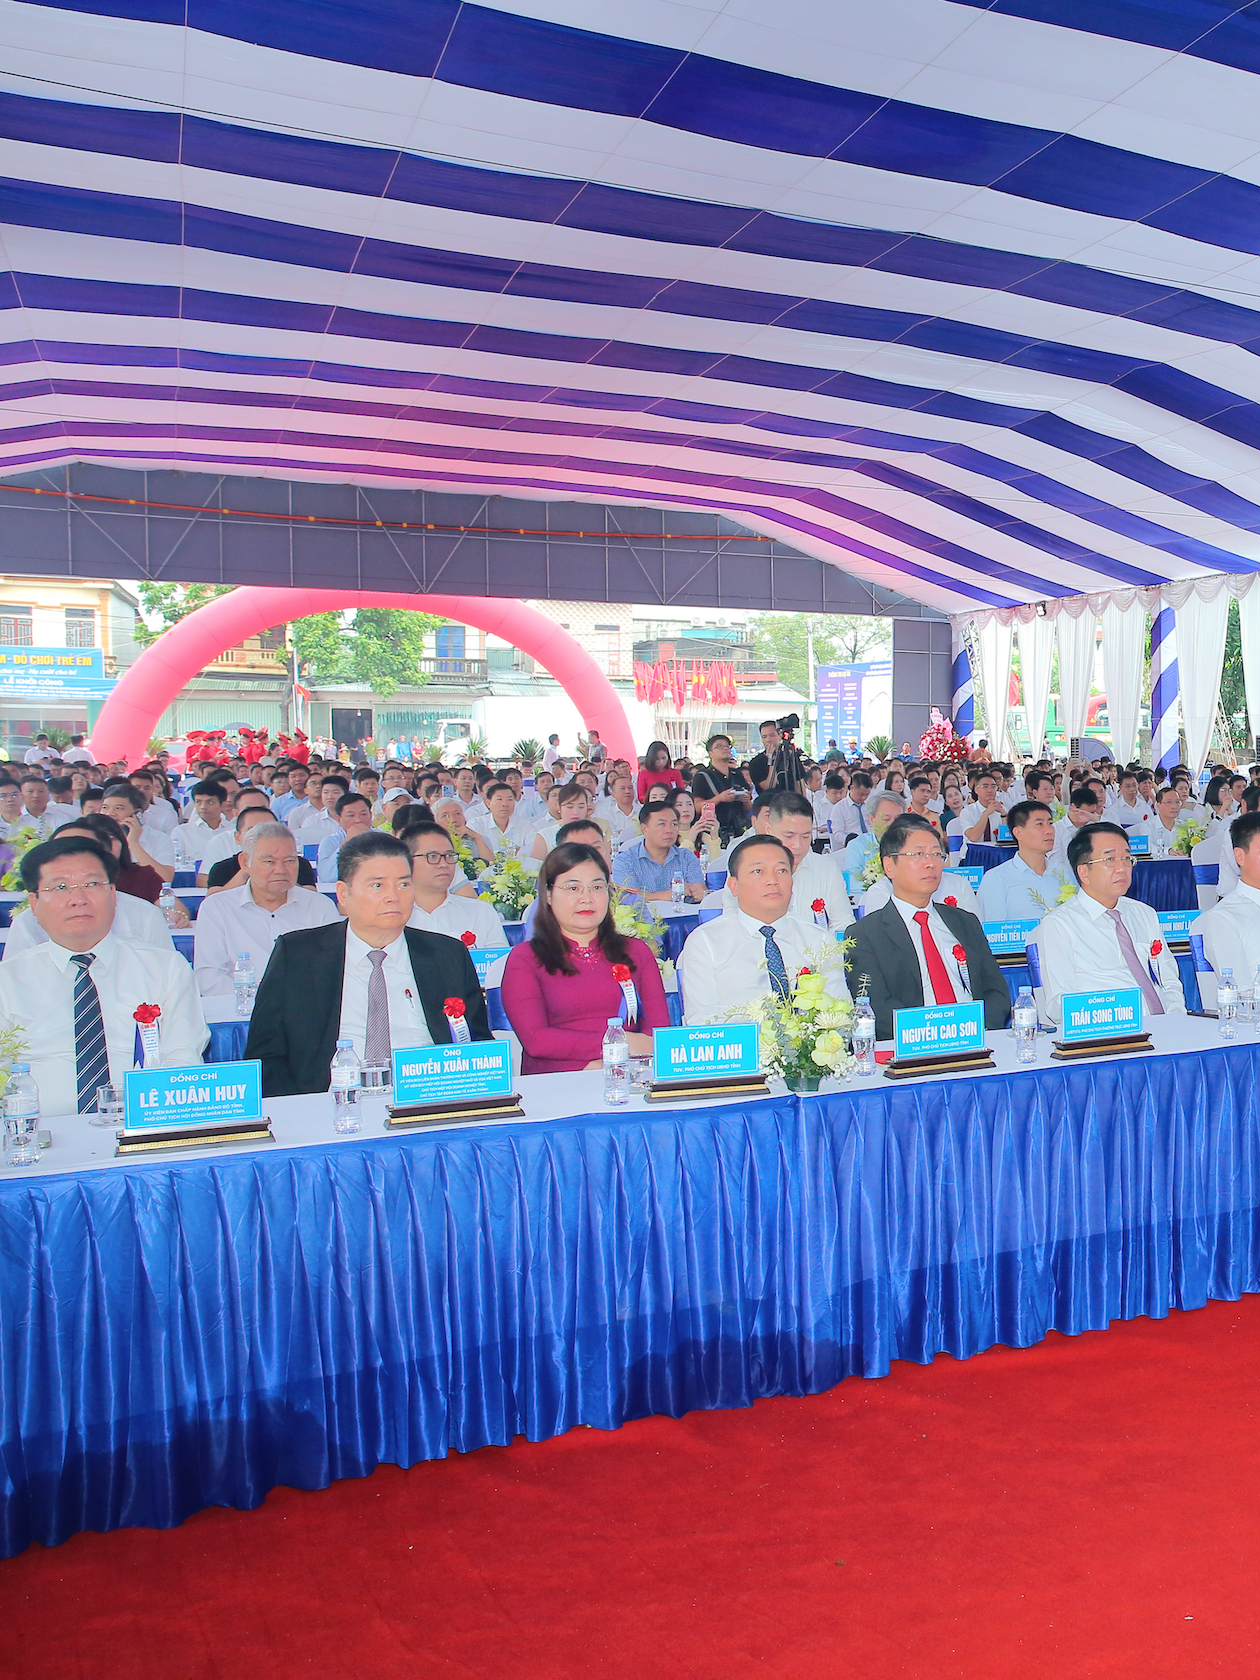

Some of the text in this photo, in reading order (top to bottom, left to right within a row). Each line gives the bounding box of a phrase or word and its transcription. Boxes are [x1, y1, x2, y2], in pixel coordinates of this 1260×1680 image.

[30, 655, 54, 665] CHƠI
[56, 653, 75, 666] TRẺ
[76, 656, 93, 666] EM
[38, 678, 64, 686] CÔNG
[987, 930, 1008, 943] NGUYỄN
[476, 960, 491, 973] XUÂ
[1088, 996, 1105, 1004] ĐỒNG
[925, 1011, 943, 1019] ĐỒNG
[1070, 1004, 1134, 1026] TRẦN SONG TÙNG
[689, 1030, 724, 1040] ĐỒNG CHÍ
[902, 1020, 977, 1044] NGUYỄN CAO SƠN
[443, 1049, 461, 1057] ÔNG
[670, 1043, 743, 1064] HÀ LAN ANH
[402, 1055, 502, 1077] NGUYỄN XUÂN THÀNH
[170, 1071, 217, 1083] ĐỒNG CHÍ
[140, 1084, 247, 1108] LÊ XUÂN HUY
